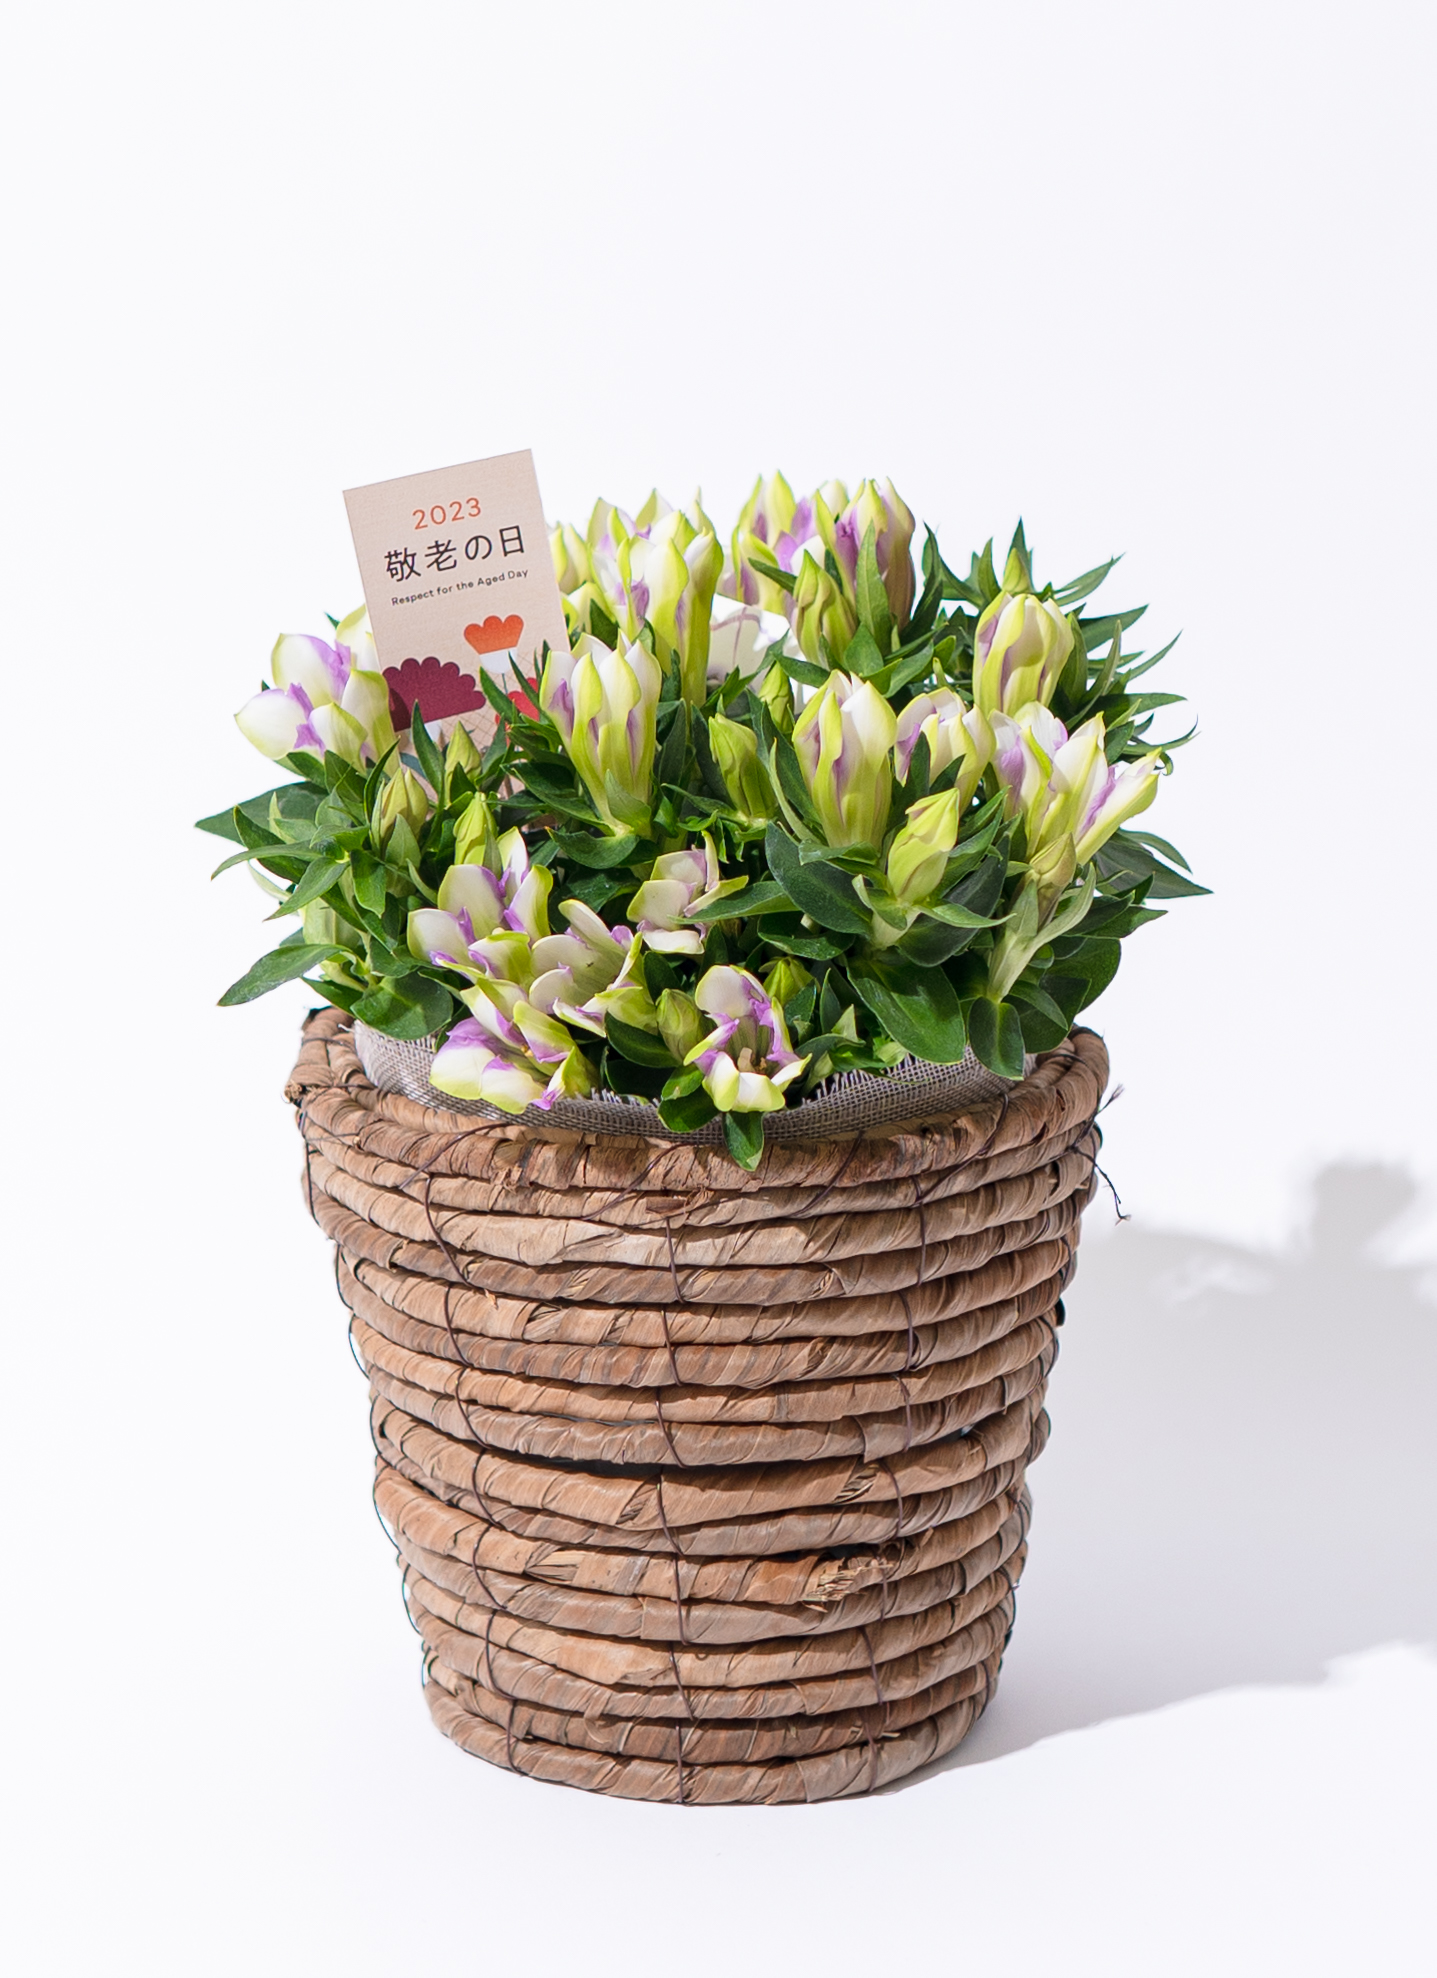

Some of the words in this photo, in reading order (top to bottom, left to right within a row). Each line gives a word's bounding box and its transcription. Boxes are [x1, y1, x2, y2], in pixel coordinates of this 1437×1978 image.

[412, 497, 481, 530] 2023
[384, 525, 525, 582] 敬老の日
[391, 589, 434, 606] Respect
[436, 585, 453, 595] for
[456, 581, 474, 591] the
[477, 573, 505, 587] Aged
[507, 569, 528, 579] Day
